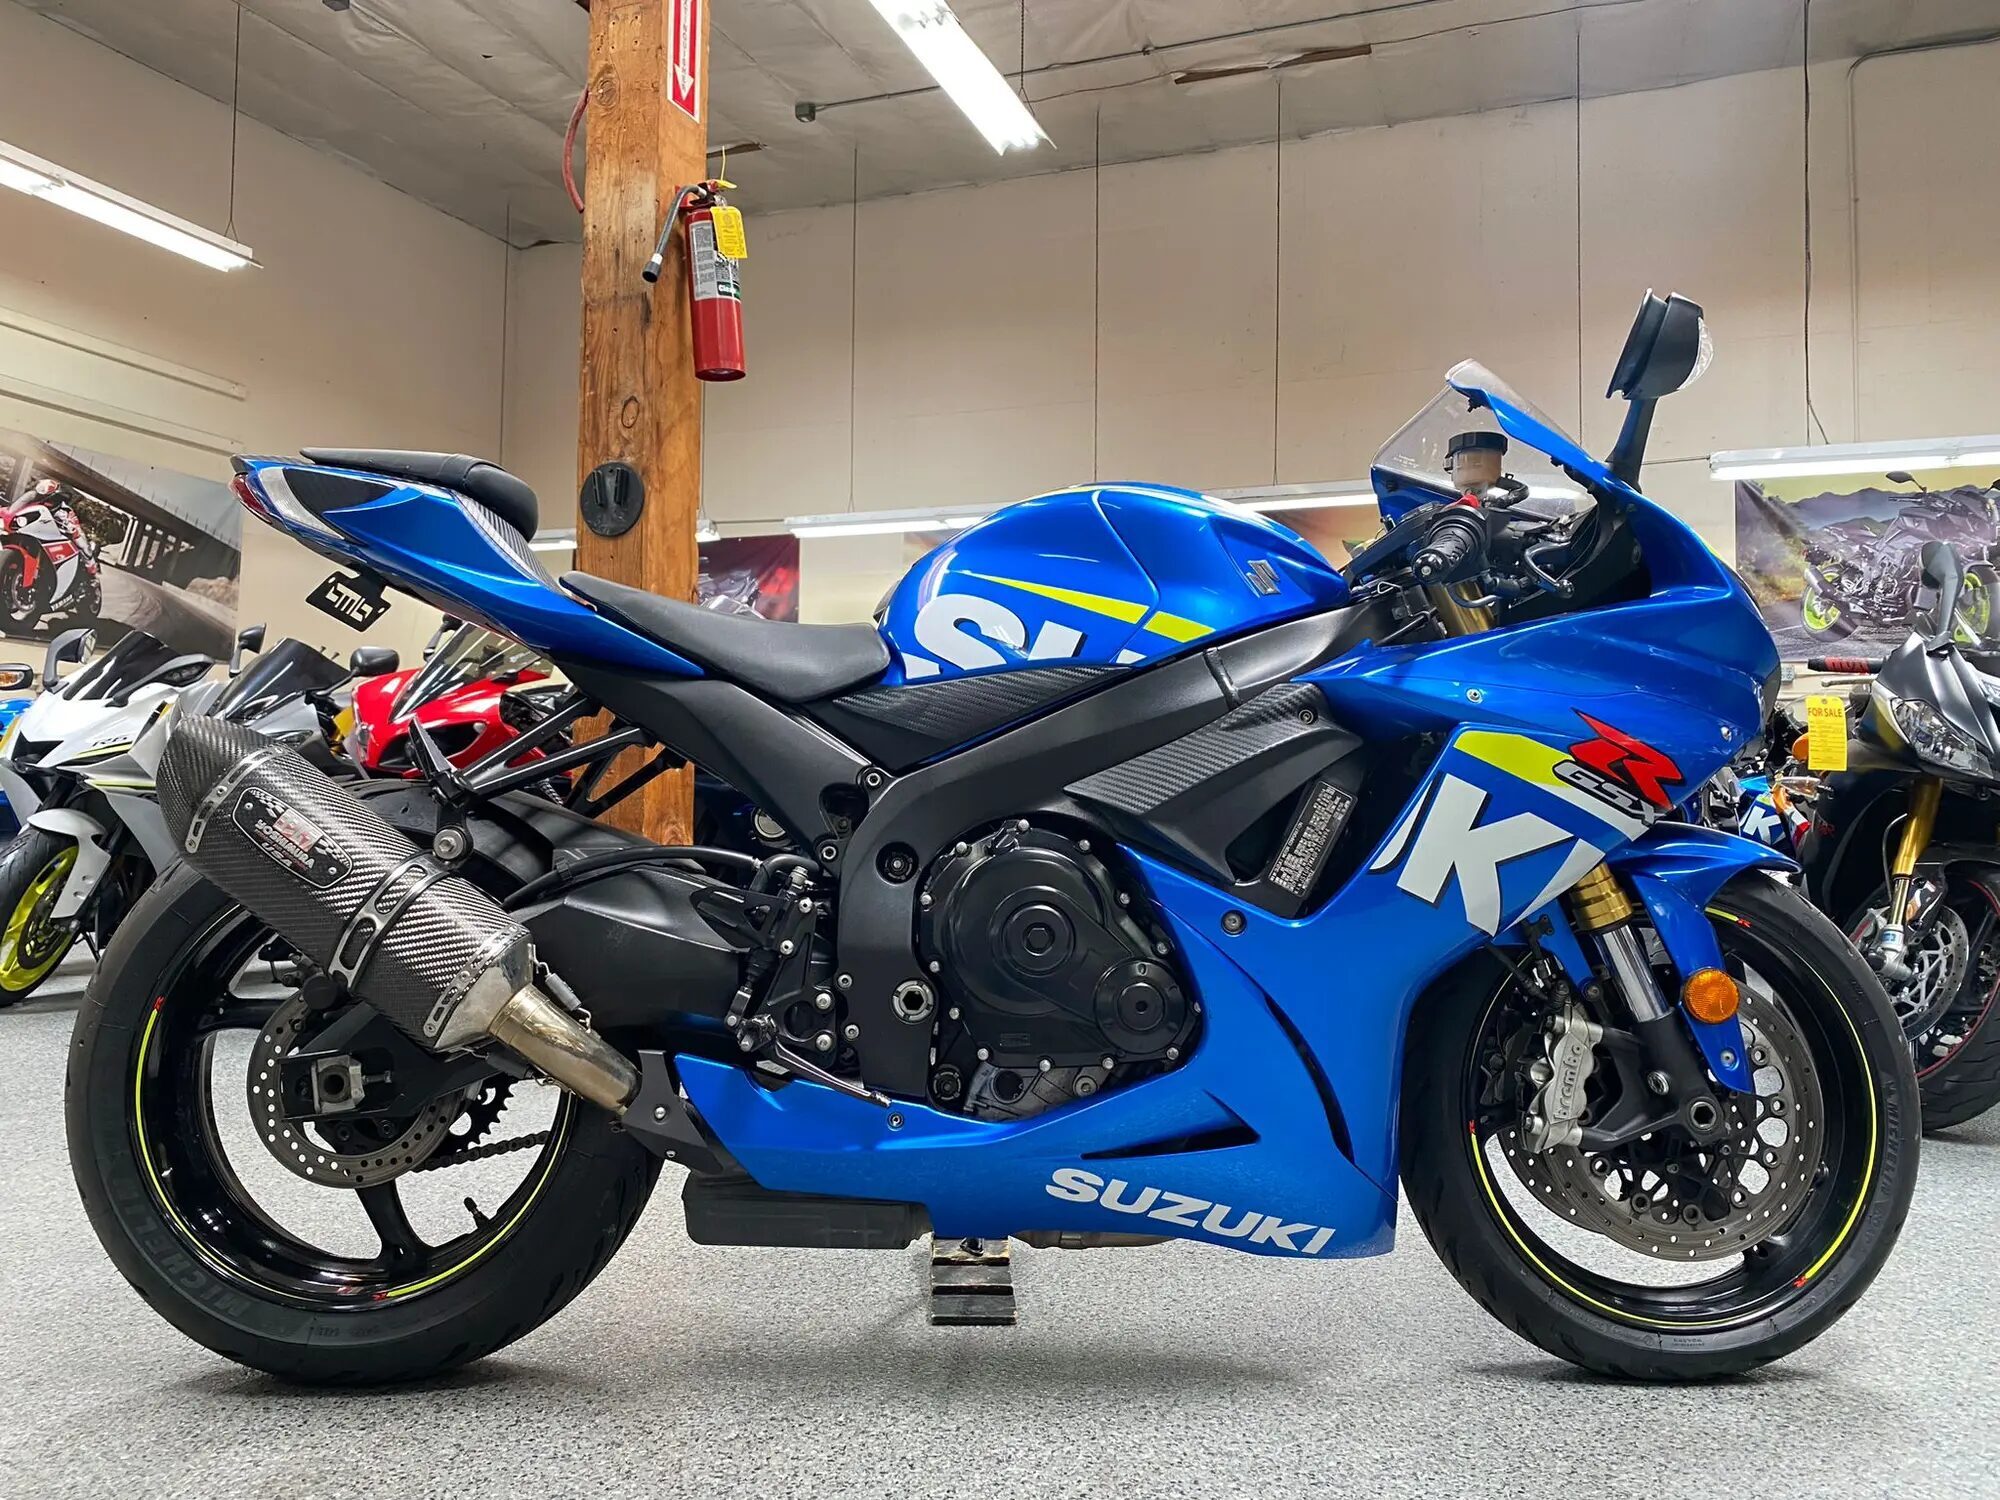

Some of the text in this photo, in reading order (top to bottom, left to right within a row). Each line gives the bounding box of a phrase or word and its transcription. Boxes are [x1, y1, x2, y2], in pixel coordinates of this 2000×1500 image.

[1807, 707, 1843, 718] FOR SALE
[255, 819, 315, 869] YOSHIMURA
[261, 842, 292, 867] USA
[1553, 1044, 1582, 1120] brembo
[1881, 1103, 1901, 1197] MICHELIN
[1045, 1168, 1336, 1254] SUZUKI
